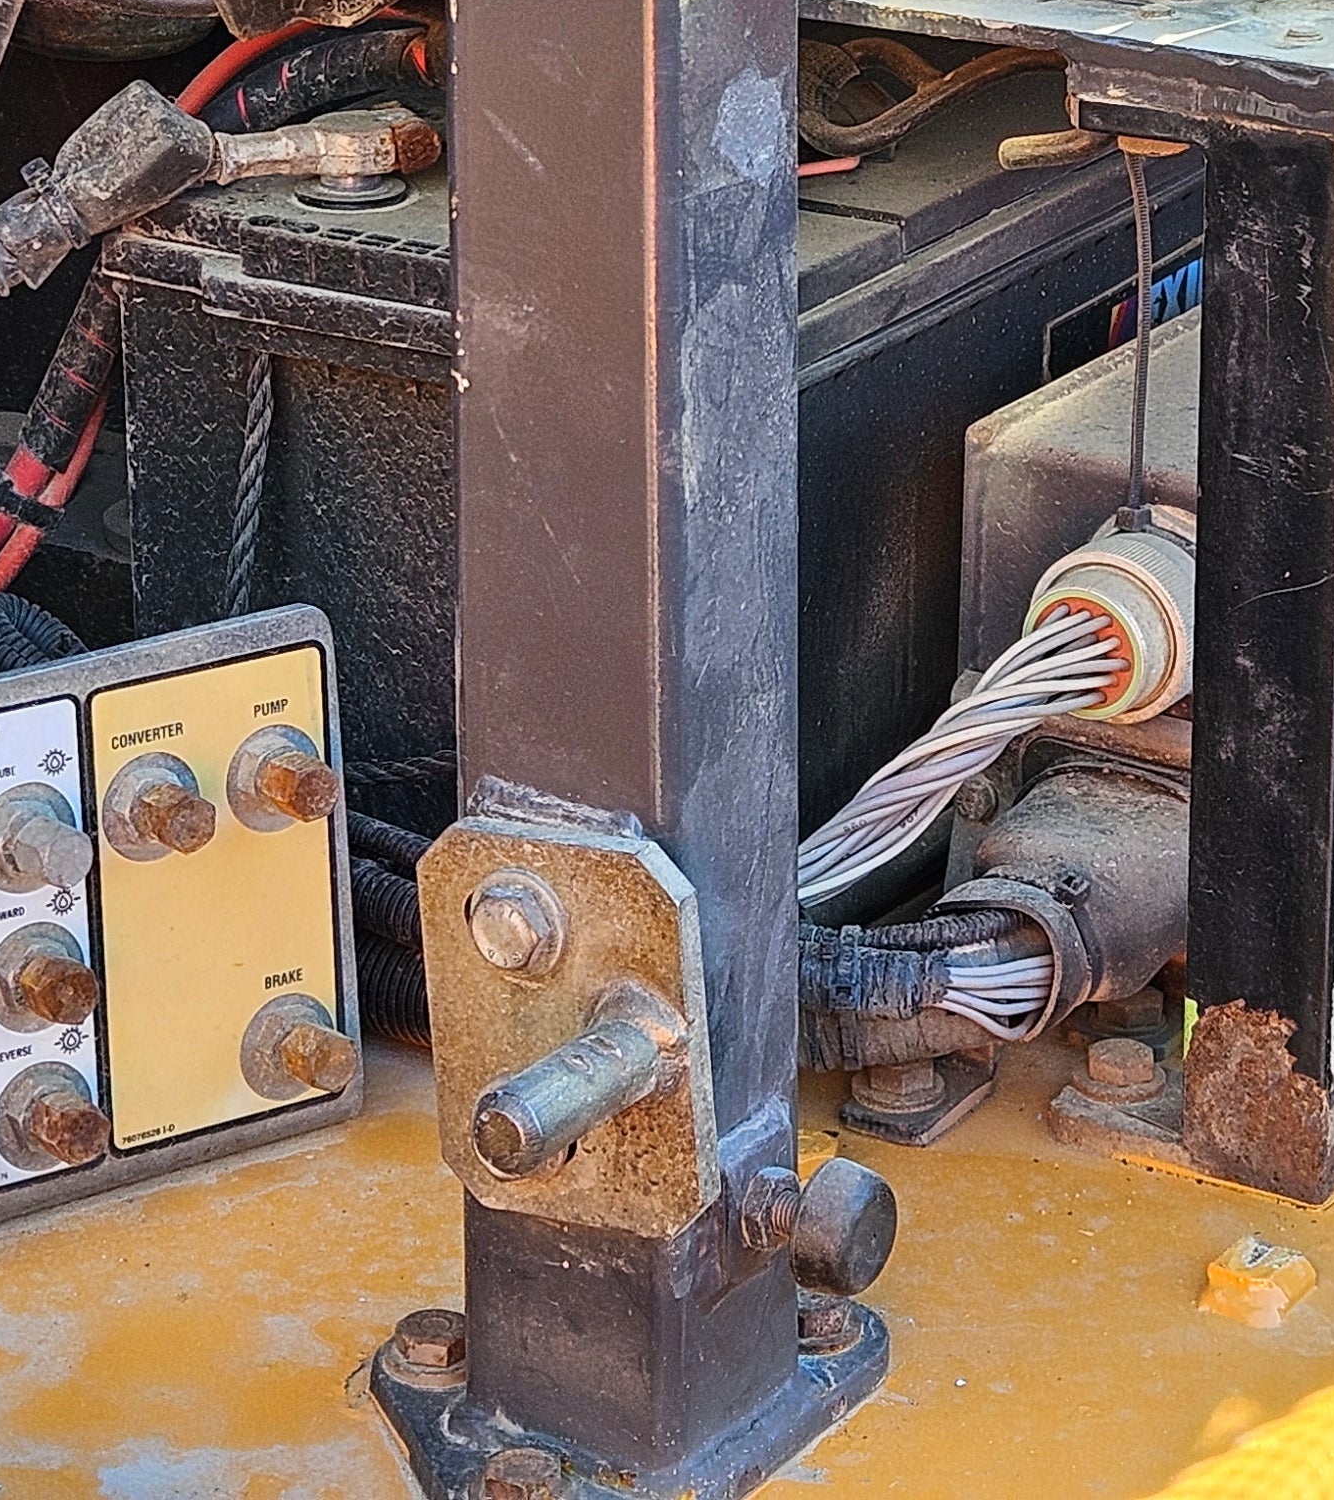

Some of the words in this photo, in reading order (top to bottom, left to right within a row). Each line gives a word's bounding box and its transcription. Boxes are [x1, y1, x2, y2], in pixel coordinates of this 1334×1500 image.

[253, 698, 289, 718] PUMP
[111, 722, 184, 750] CONVERTER
[264, 967, 304, 990] BRAKE
